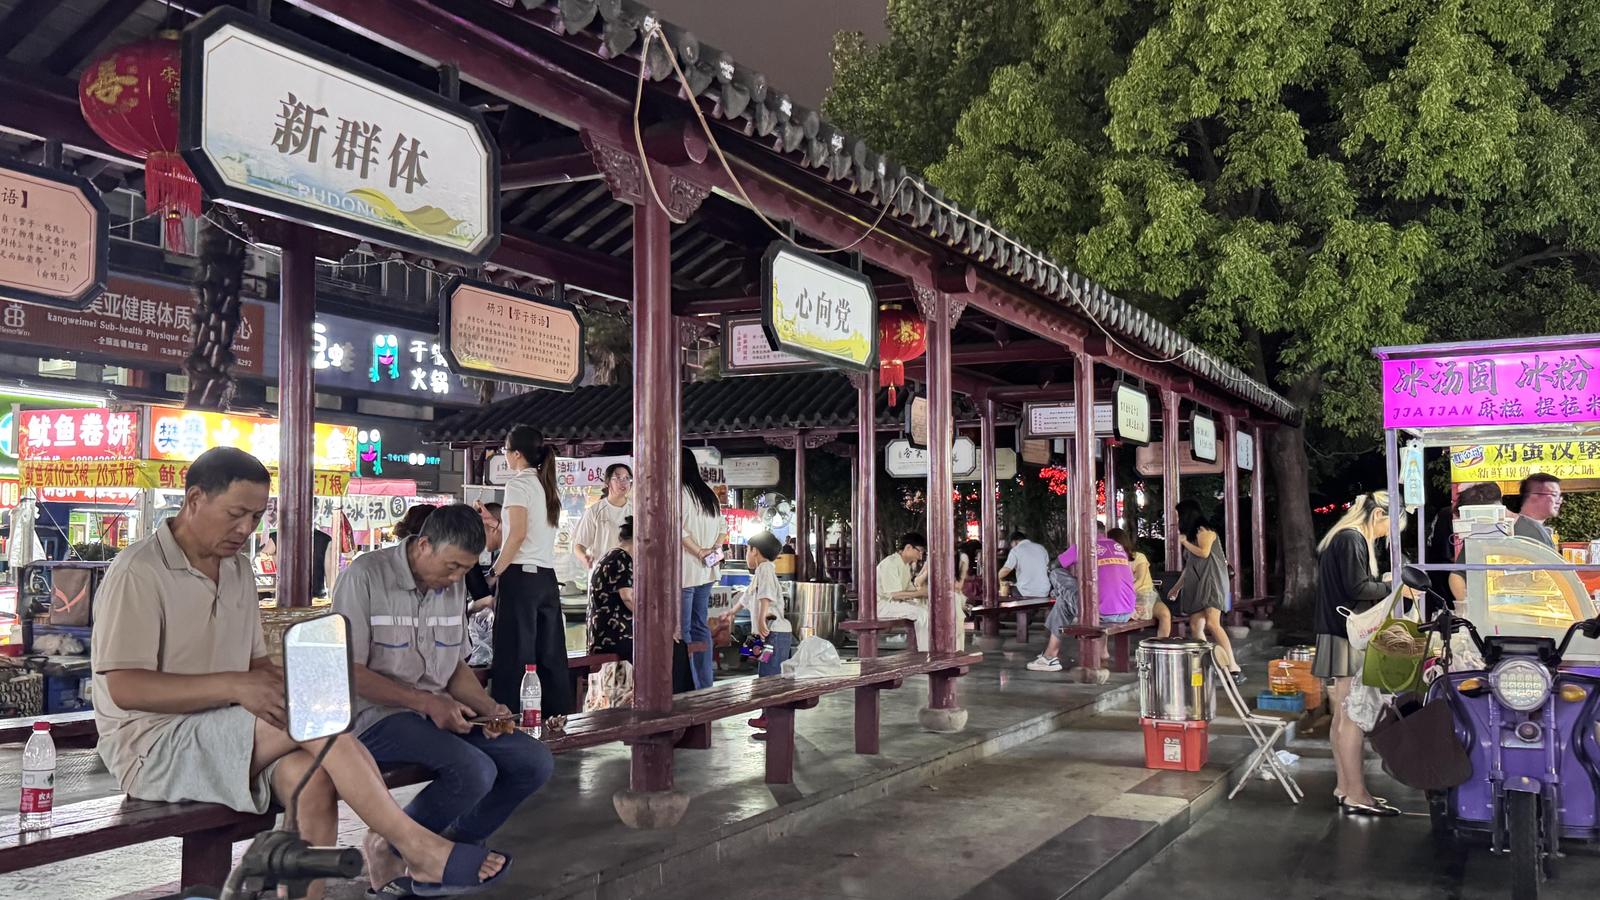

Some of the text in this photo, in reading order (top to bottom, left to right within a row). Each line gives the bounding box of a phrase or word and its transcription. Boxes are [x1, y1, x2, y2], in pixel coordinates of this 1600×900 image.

[271, 91, 429, 194] 新群体
[795, 287, 851, 334] 心向党
[99, 321, 143, 336] Sub-health
[146, 328, 179, 343] Physique
[410, 367, 449, 394] 火锅
[1392, 353, 1595, 398] 冰汤圆 冰粉
[27, 412, 132, 447] 鱿鱼卷饼
